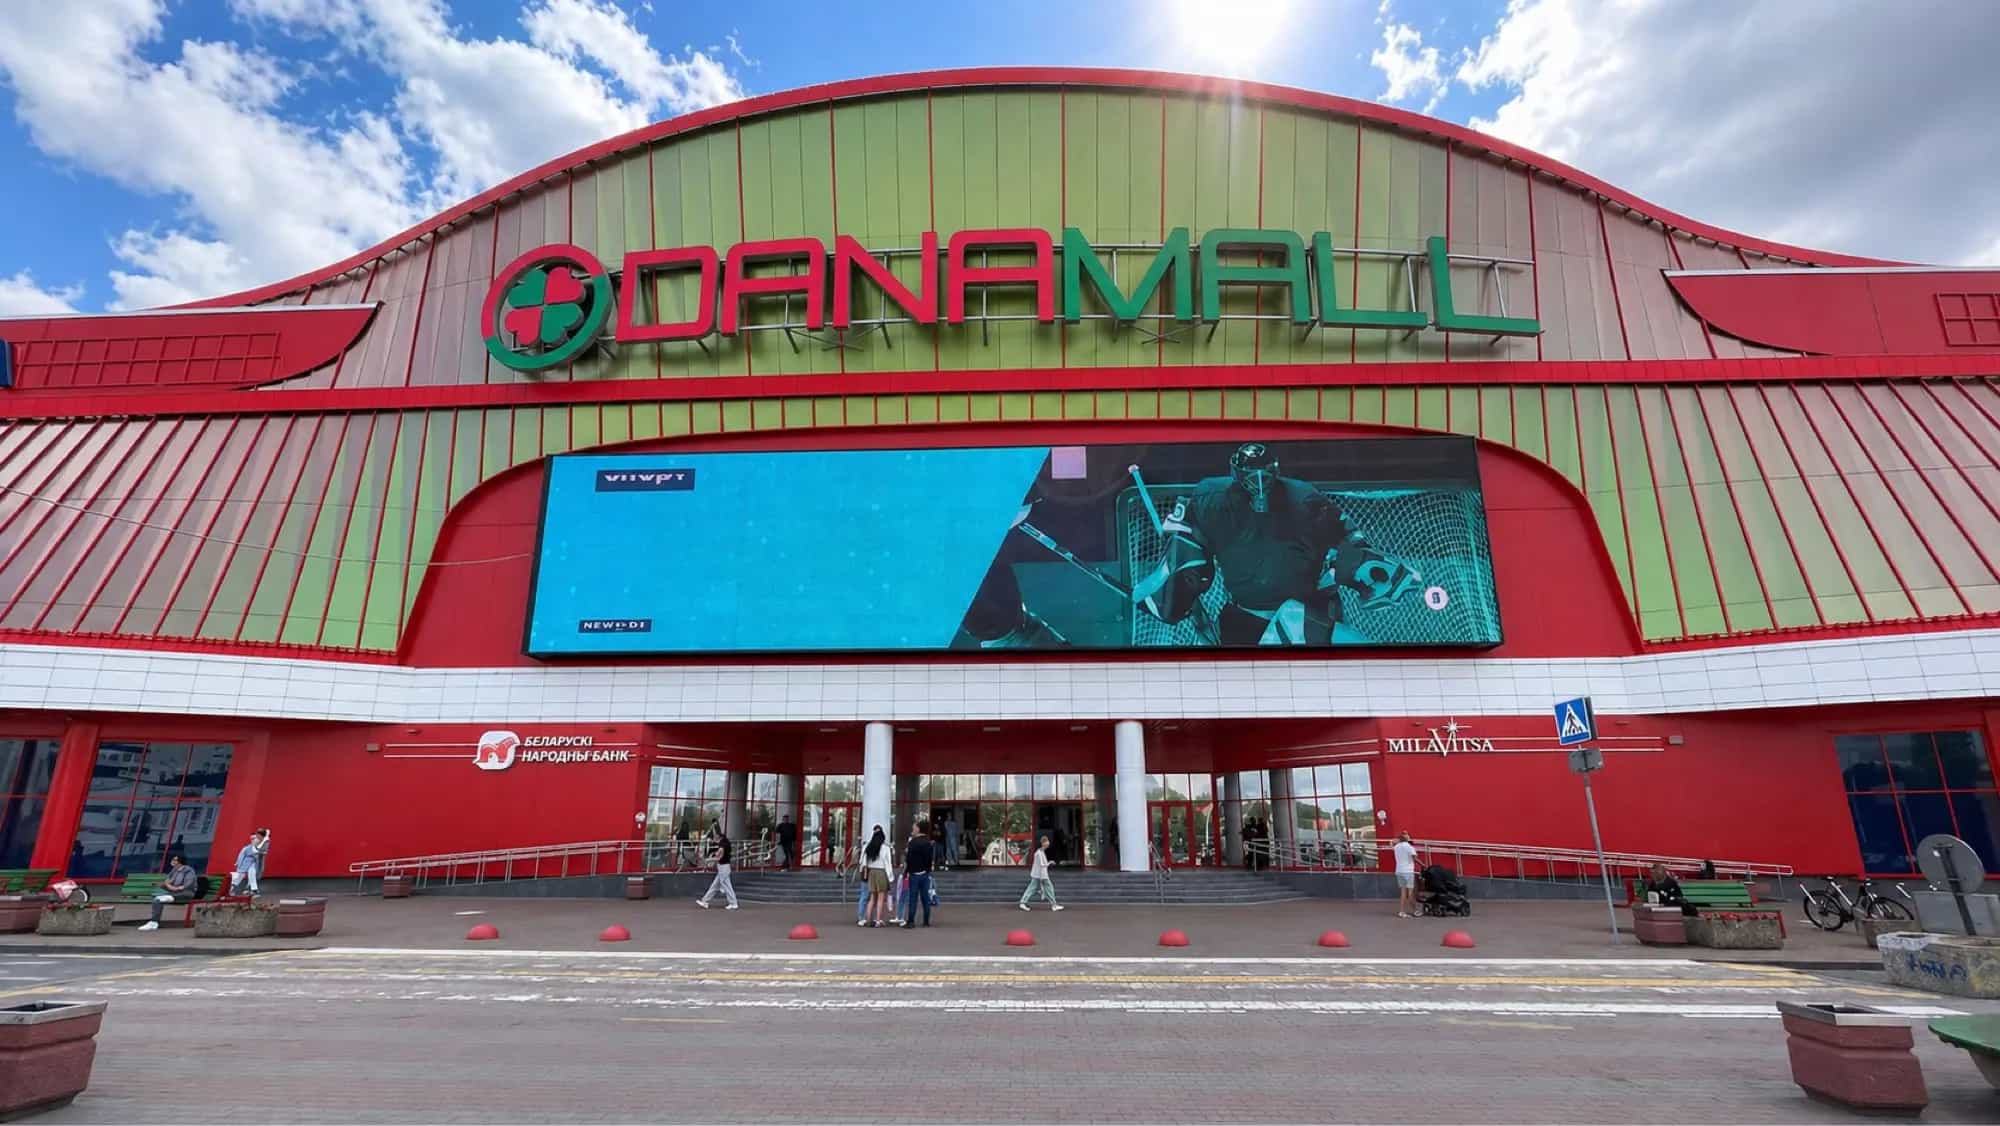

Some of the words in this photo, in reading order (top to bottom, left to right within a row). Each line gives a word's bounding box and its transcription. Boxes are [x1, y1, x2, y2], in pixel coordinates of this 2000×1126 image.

[524, 736, 593, 747] БЕЛАРУСКІ
[1386, 728, 1494, 757] MILAVITSA
[521, 749, 590, 764] НАРОДНЫ
[591, 750, 629, 762] БАНК
